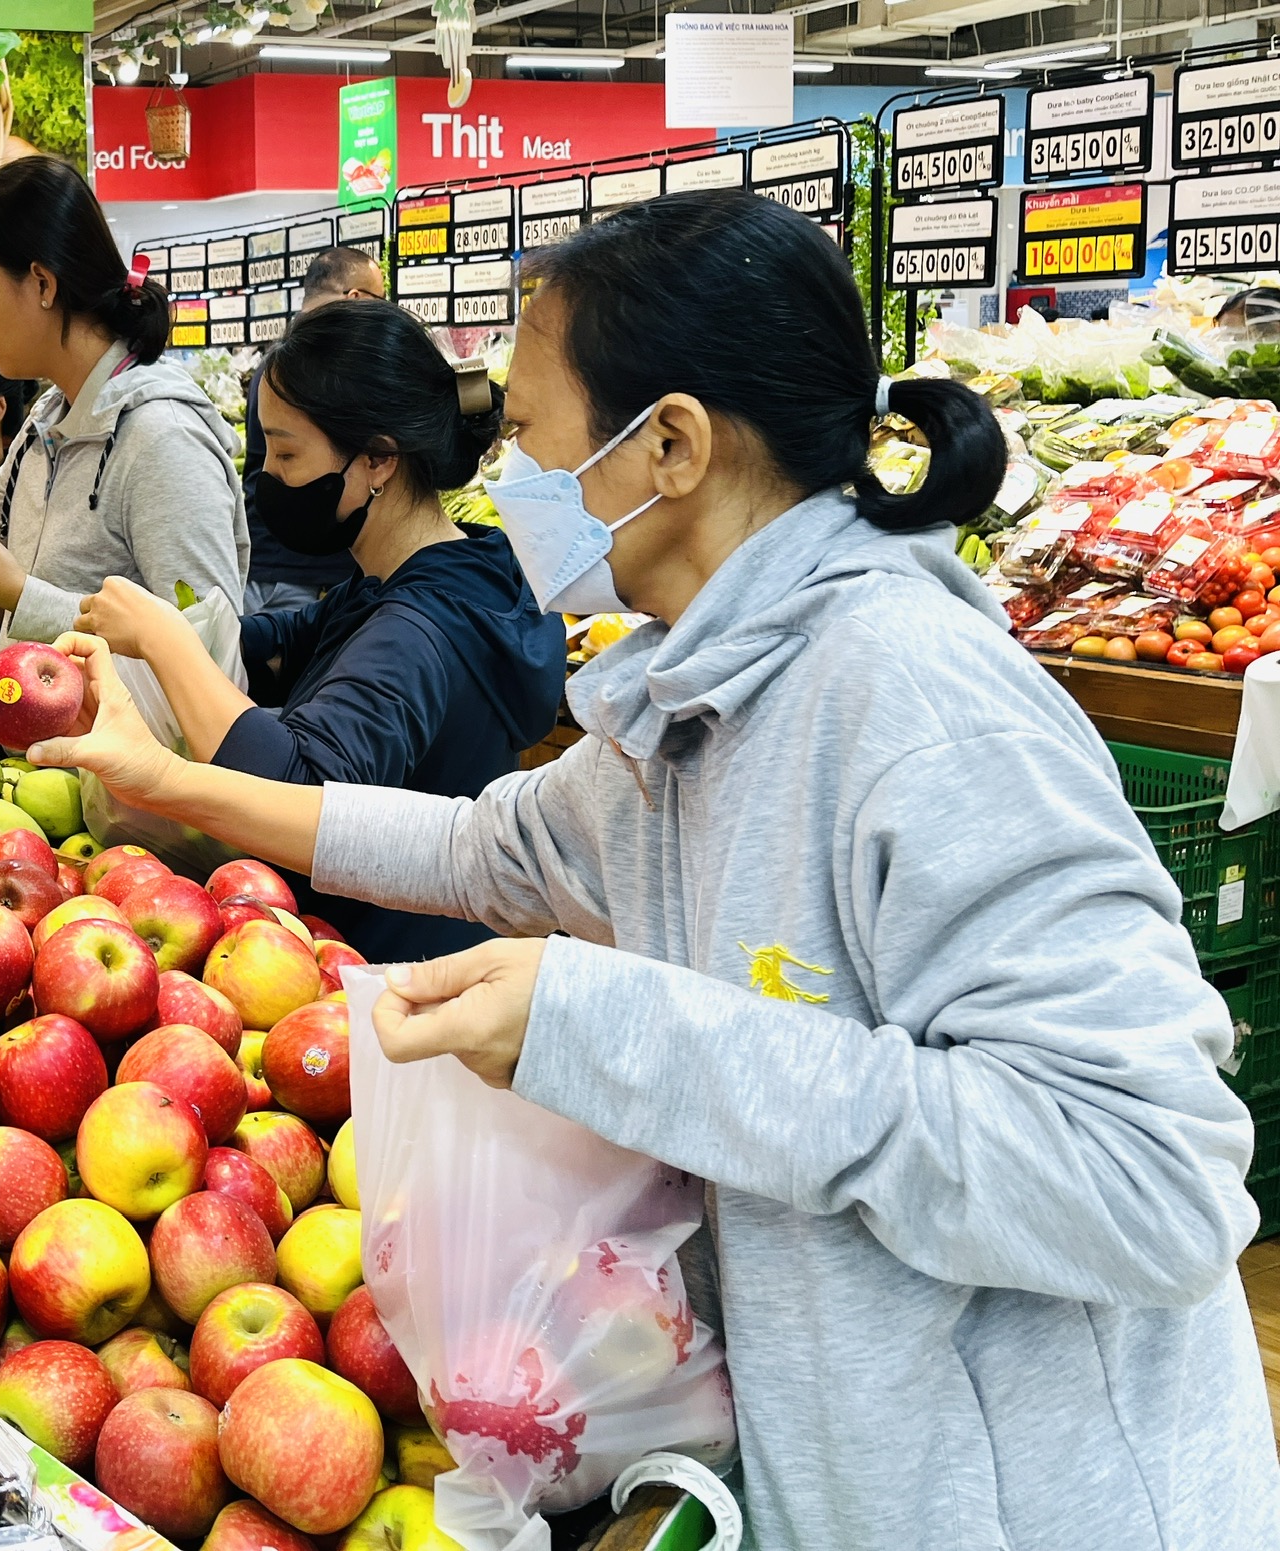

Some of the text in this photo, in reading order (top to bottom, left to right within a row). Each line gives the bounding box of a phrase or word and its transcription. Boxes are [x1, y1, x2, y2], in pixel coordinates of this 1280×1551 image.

[676, 22, 699, 31] THÔNG
[1194, 82, 1211, 91] Dưa
[1212, 80, 1225, 88] leo
[1226, 77, 1250, 88] giống
[1047, 102, 1062, 110] Dưa
[1076, 95, 1094, 105] baby
[1095, 90, 1138, 103] CoopSelect
[422, 113, 571, 169] Thịt Meat
[1185, 117, 1277, 151] 32.900
[1034, 136, 1117, 165] 34.500
[901, 153, 973, 183] 64.500
[1025, 194, 1060, 210] Khuyến
[1201, 190, 1219, 198] Dưa
[1220, 188, 1233, 196] leo
[1070, 206, 1087, 215] Dưa
[456, 228, 497, 248] 28.900
[1180, 230, 1272, 260] 25.500
[896, 252, 965, 275] 65.000
[1032, 240, 1111, 268] 16.000
[457, 300, 496, 317] 19.000
